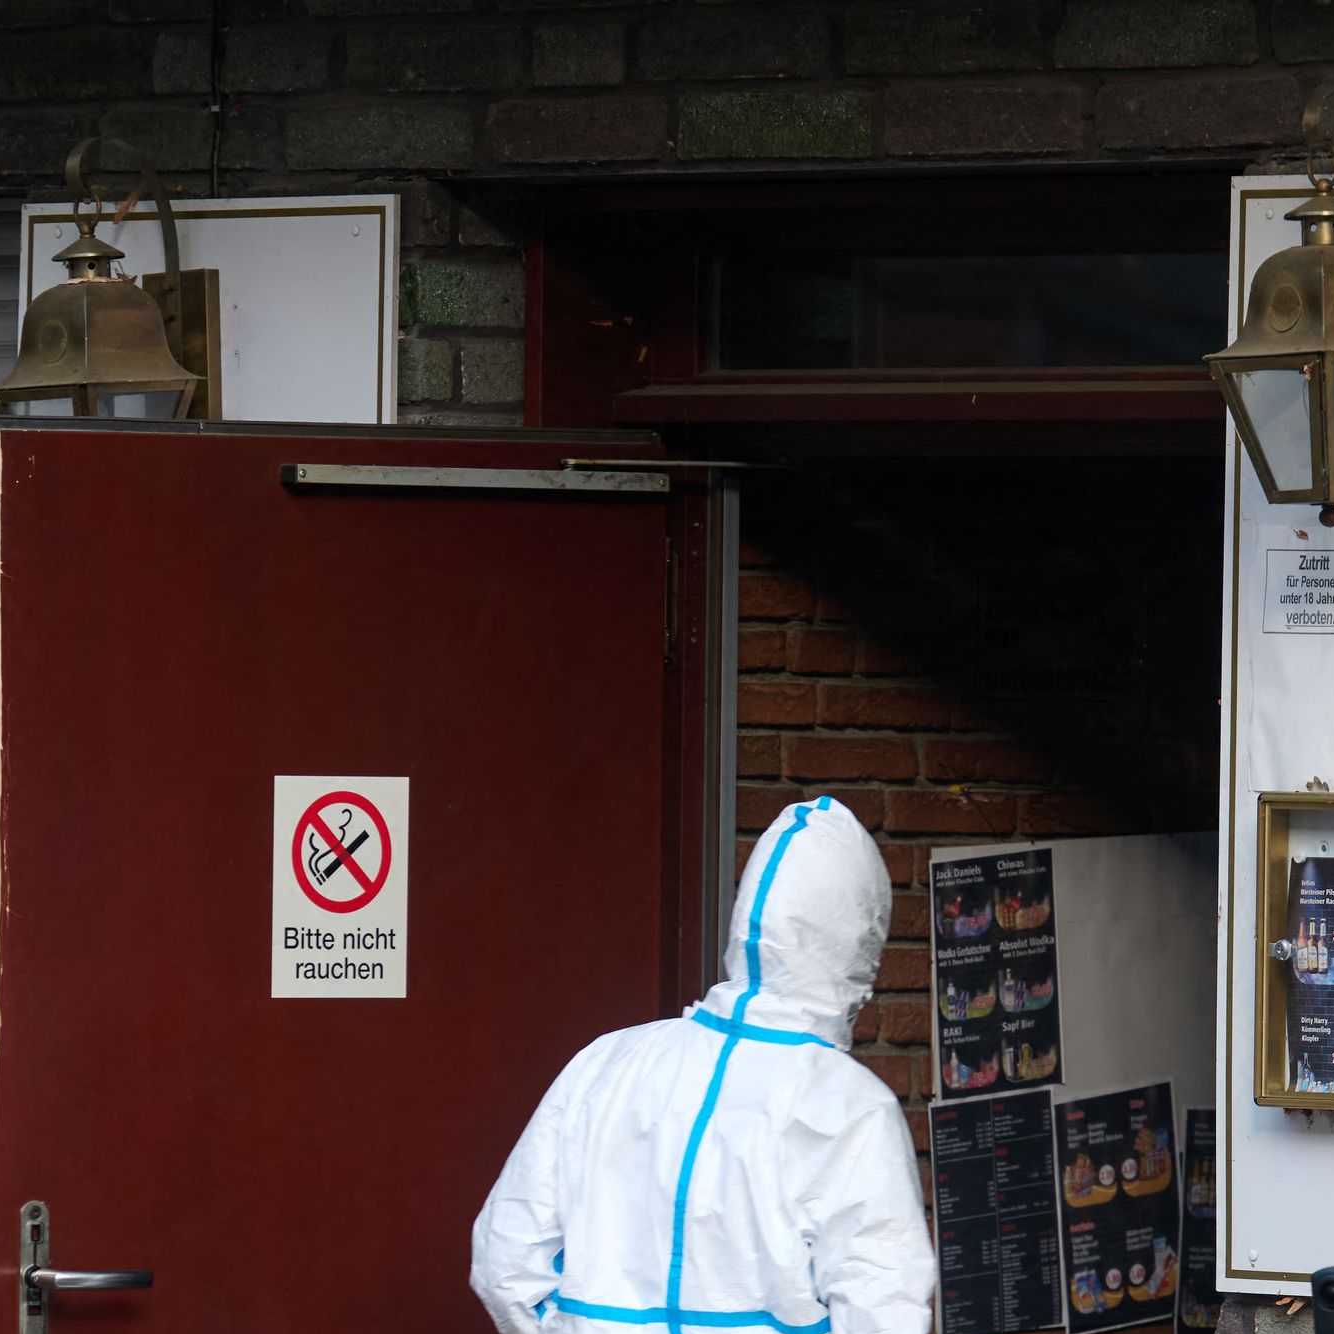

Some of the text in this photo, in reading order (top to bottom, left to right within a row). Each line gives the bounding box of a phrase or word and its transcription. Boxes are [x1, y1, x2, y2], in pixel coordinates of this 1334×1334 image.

[1298, 554, 1331, 571] Zutritt
[1286, 575, 1299, 589] für
[1280, 592, 1301, 605] unter
[1303, 592, 1314, 605] 18
[936, 866, 982, 880] Jack Daniels
[284, 927, 396, 950] Bitte nicht
[999, 939, 1028, 951] Absolut
[295, 957, 384, 980] rauchen
